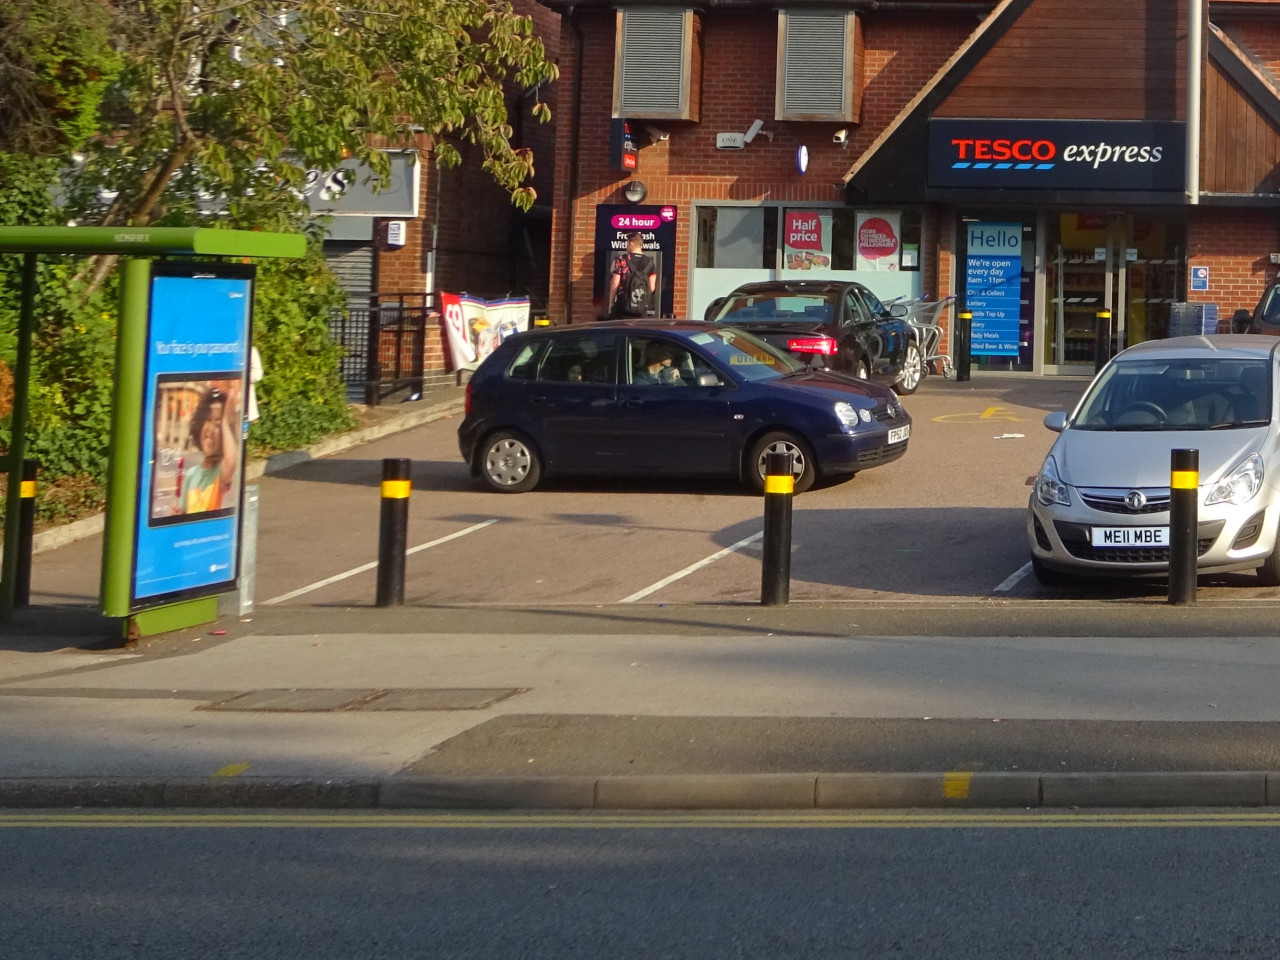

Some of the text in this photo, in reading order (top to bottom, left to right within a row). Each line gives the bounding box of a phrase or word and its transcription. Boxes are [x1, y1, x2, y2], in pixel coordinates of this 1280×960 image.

[951, 139, 1163, 169] TESCO express
[618, 217, 655, 227] 24 hour
[792, 219, 817, 230] Half
[790, 231, 818, 243] price
[970, 230, 1019, 248] Hello
[968, 259, 1011, 268] We're open
[990, 268, 1004, 276] day
[1134, 529, 1163, 543] MBE
